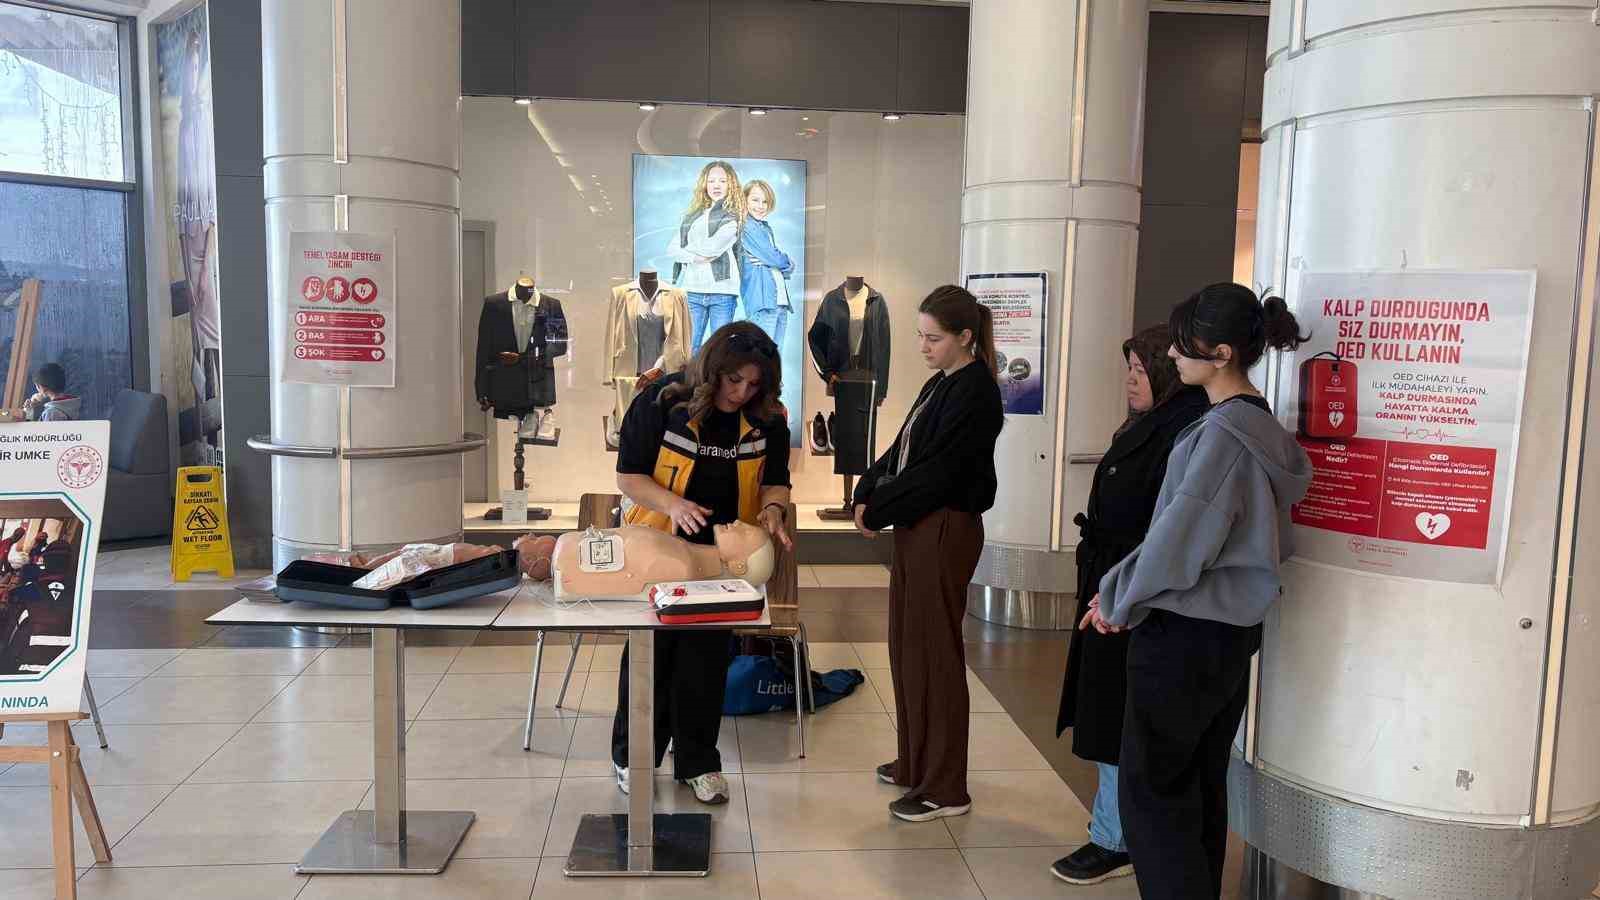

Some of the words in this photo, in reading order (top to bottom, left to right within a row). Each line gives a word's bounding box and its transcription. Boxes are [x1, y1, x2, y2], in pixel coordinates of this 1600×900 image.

[1323, 299, 1365, 317] KALP
[308, 315, 326, 323] ARA
[1369, 321, 1465, 344] DURMAYIN,
[1336, 341, 1366, 360] OED
[1371, 342, 1461, 364] KULLANIN
[1393, 372, 1414, 381] OED
[1379, 391, 1405, 400] KALP
[1407, 393, 1477, 406] DURMASINDA
[1328, 401, 1345, 410] OED
[1384, 402, 1429, 412] HAYATTA
[1431, 405, 1469, 415] KALMA
[1329, 443, 1346, 451] OED
[15, 450, 51, 460] UMKE
[1429, 453, 1449, 461] OED
[183, 535, 198, 543] WET
[200, 534, 223, 542] FLOOR
[756, 679, 794, 695] Little
